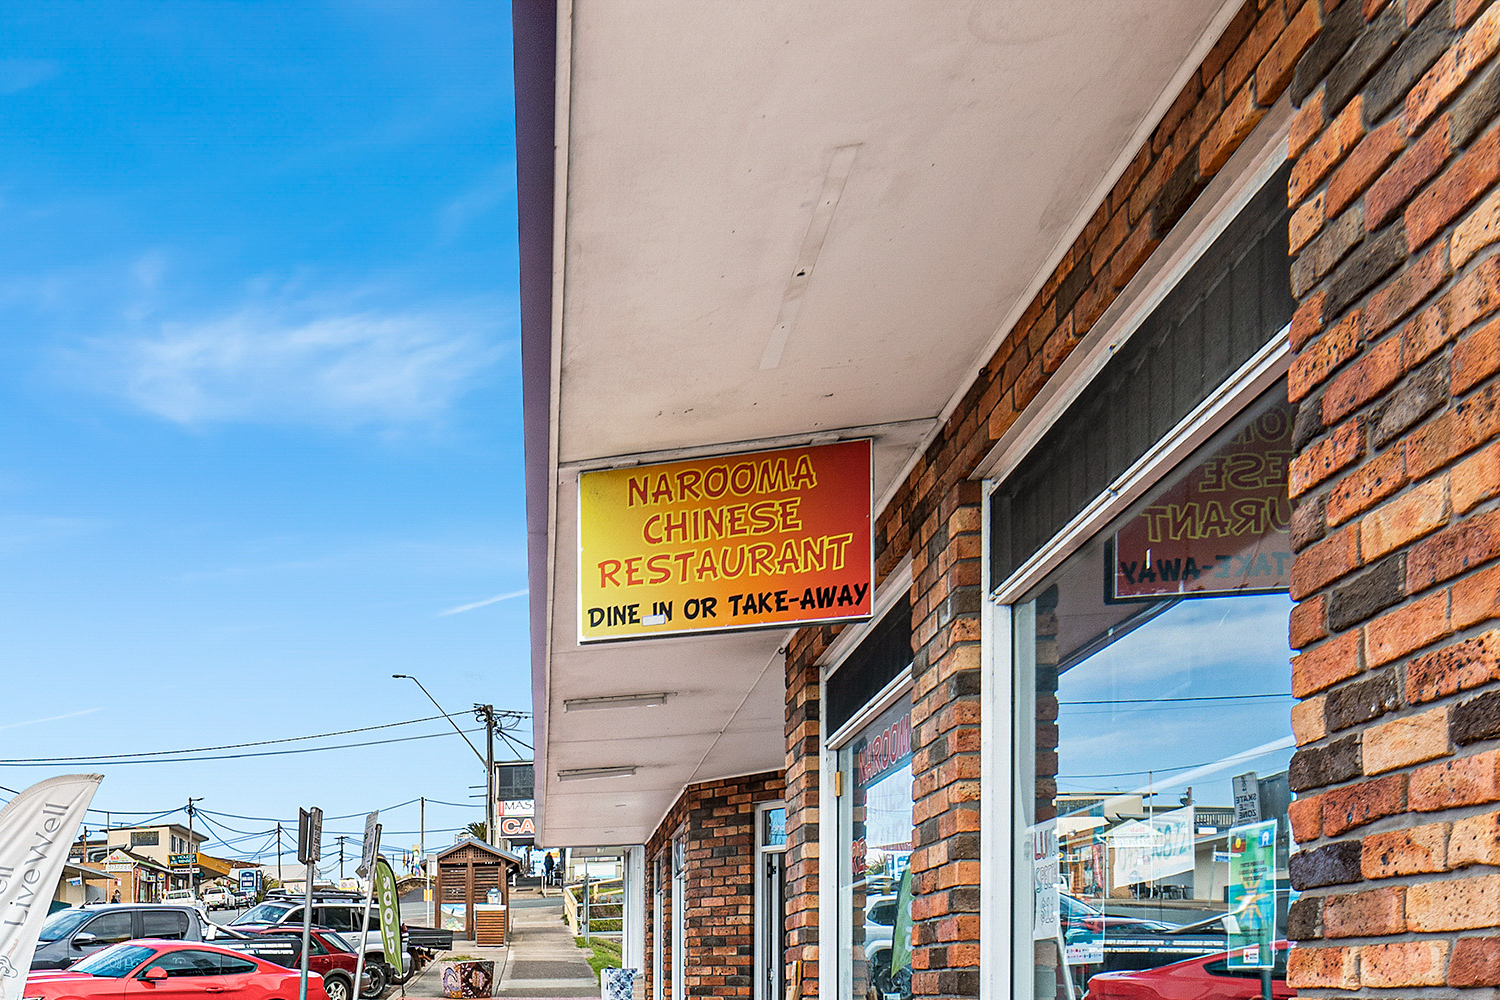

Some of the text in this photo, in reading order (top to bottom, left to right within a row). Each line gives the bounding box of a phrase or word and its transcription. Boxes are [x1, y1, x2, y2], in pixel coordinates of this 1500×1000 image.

[627, 454, 817, 508] NAROOMA
[642, 497, 802, 546] CHINESE
[597, 533, 853, 590] RESTAURANT
[588, 603, 641, 628] DINE
[684, 596, 717, 620] OR
[728, 582, 869, 617] TAKE-AWAY
[858, 713, 912, 787] NAROOM
[382, 874, 396, 955] crocs
